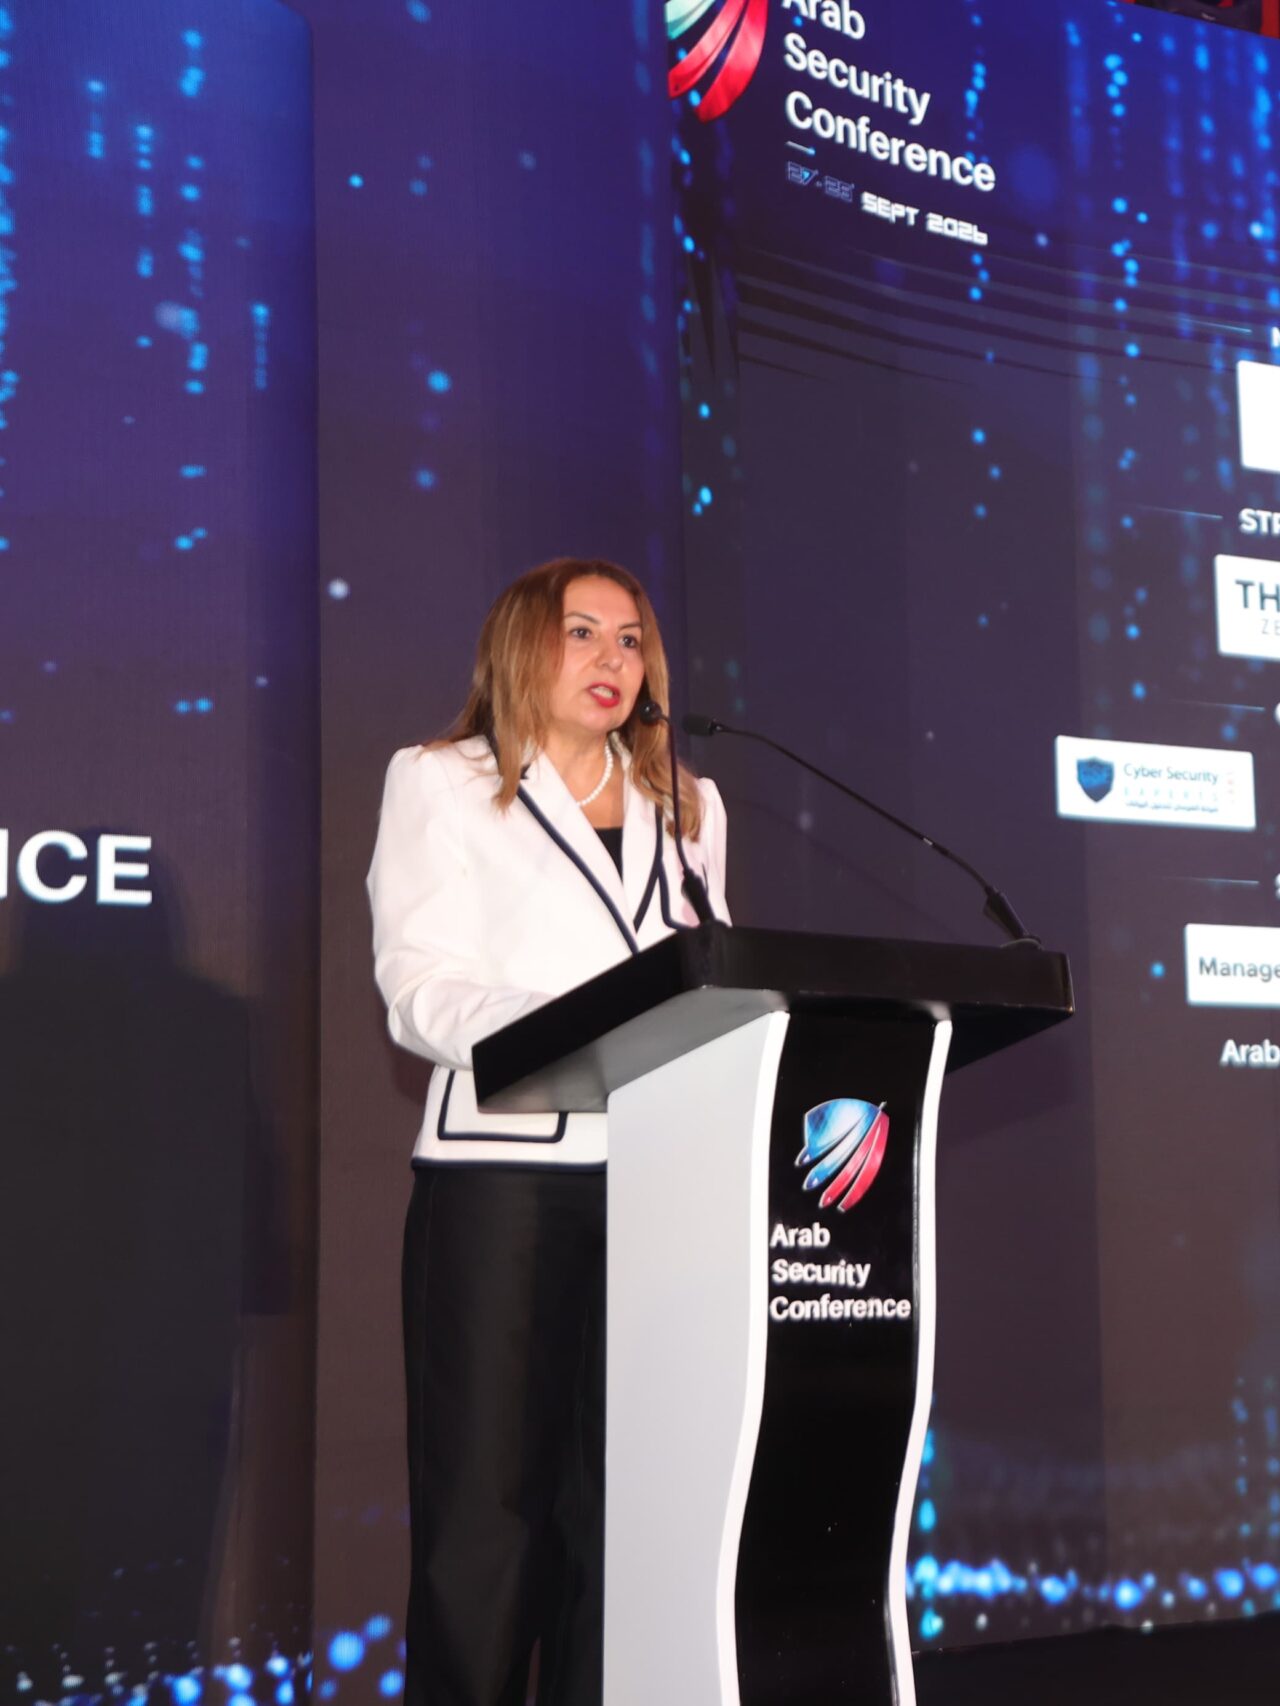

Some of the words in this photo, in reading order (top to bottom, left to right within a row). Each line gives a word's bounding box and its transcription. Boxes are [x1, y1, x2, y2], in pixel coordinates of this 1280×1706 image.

[784, 32, 931, 125] Security
[785, 91, 996, 191] Conference
[861, 191, 920, 226] SEPT
[926, 212, 989, 246] 2026
[1123, 763, 1162, 779] Cyber
[1166, 767, 1218, 785] Security
[0, 828, 152, 906] CE
[1220, 1039, 1280, 1067] Arab
[770, 1222, 831, 1249] Arab
[771, 1258, 871, 1288] Security
[769, 1293, 911, 1321] Conference
